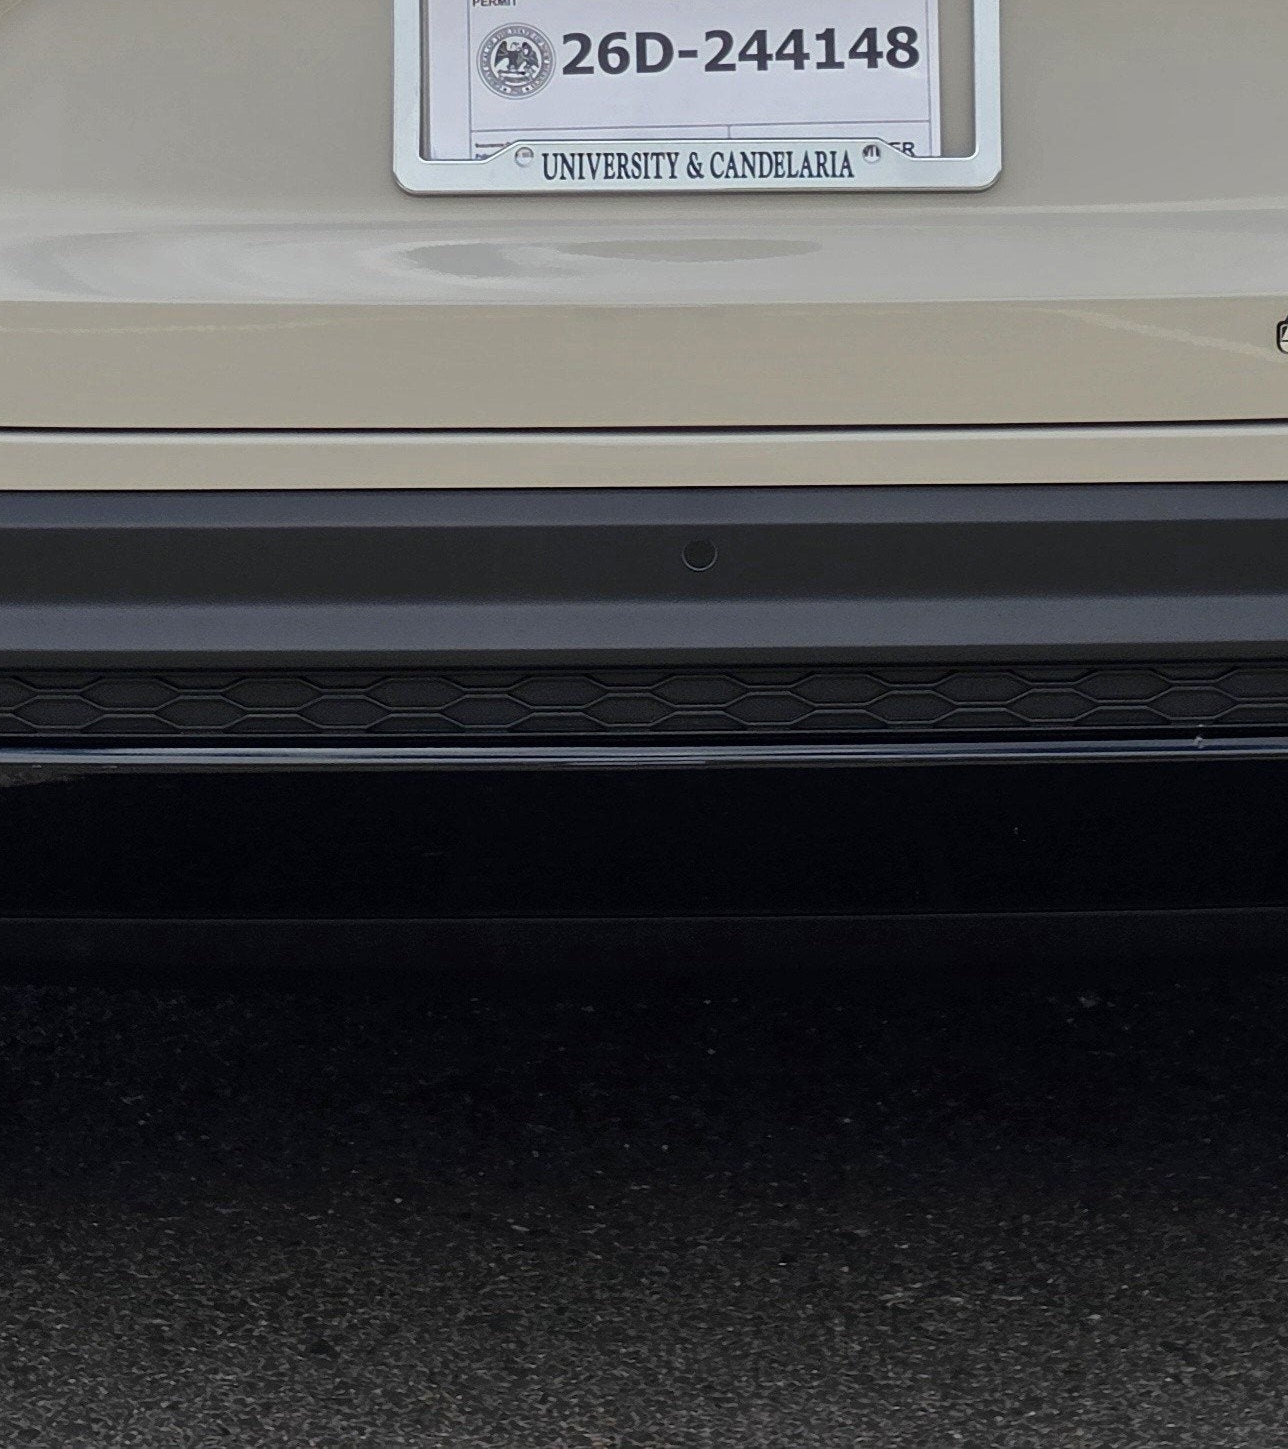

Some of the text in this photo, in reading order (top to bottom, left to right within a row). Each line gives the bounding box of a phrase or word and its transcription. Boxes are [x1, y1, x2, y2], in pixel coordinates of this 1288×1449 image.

[561, 25, 920, 76] 26D-244148
[541, 152, 679, 181] UNIVERSITY
[686, 152, 705, 179] &
[709, 149, 855, 179] CANDELARIA
